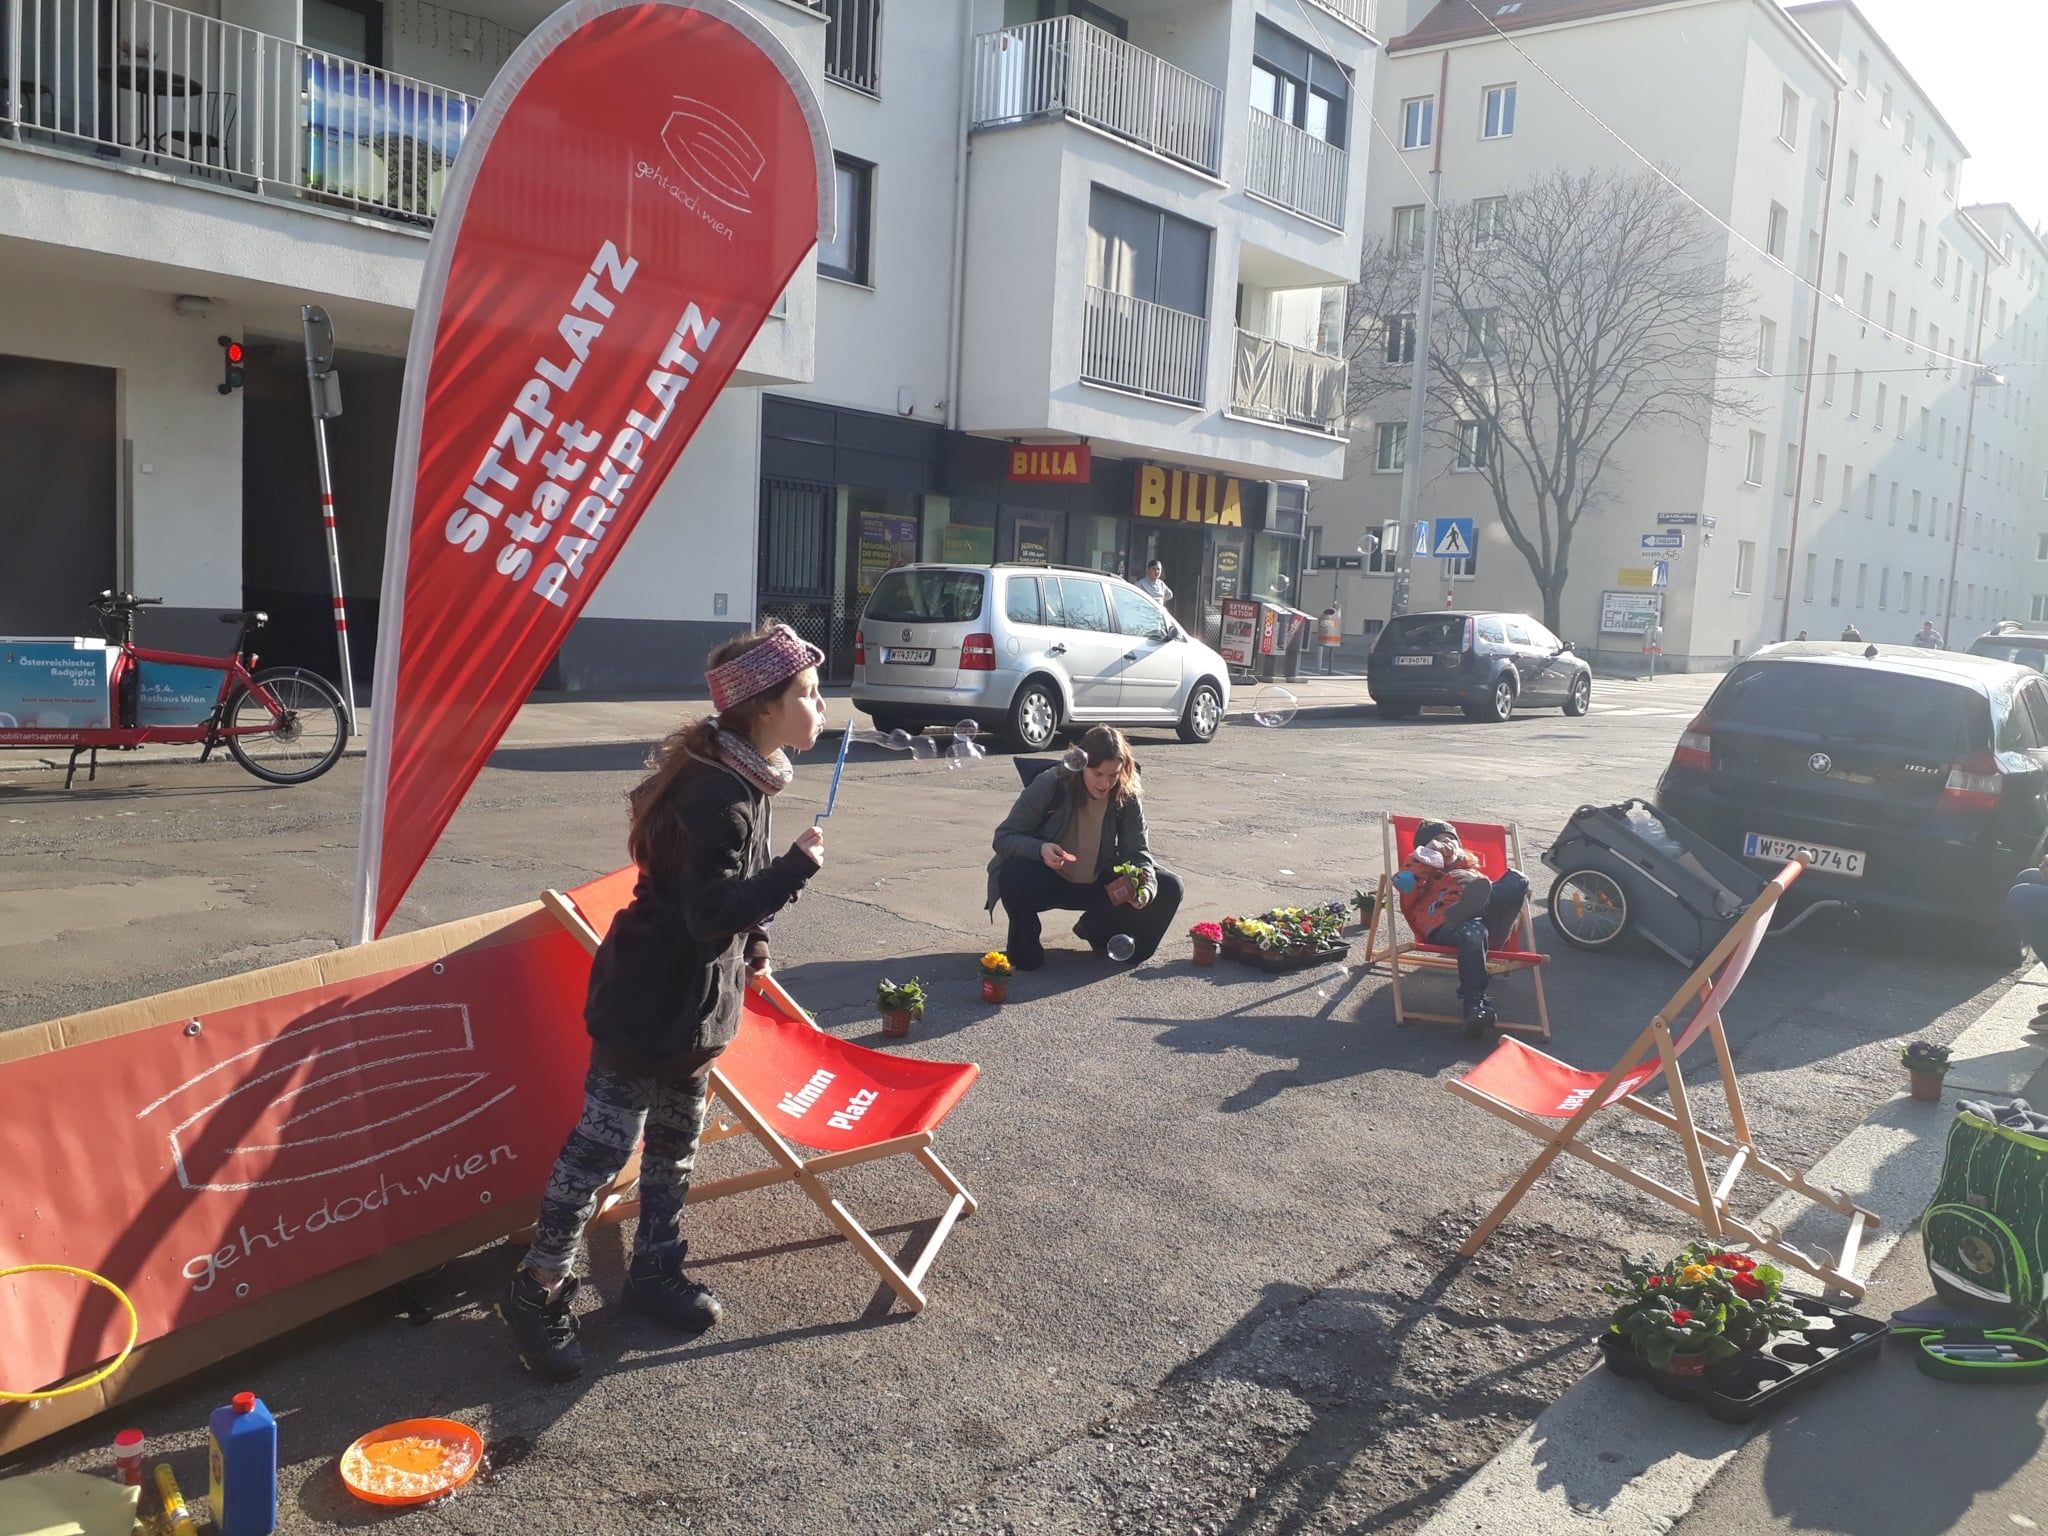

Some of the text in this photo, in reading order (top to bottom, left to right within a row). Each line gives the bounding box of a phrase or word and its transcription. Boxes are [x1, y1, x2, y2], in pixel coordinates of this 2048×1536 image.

[445, 239, 639, 553] SITZPLATZ
[532, 301, 721, 608] PARKPLATZ
[1012, 451, 1078, 475] BILLA
[496, 419, 602, 582] statt
[1140, 464, 1242, 527] BILLA
[1229, 603, 1254, 611] EXTREM
[1229, 610, 1253, 618] AKTION
[19, 656, 96, 667] Österreichischer
[51, 668, 96, 678] Radgipfel
[72, 678, 96, 687] 2022
[140, 694, 206, 704] Rathaus Wien
[1760, 838, 1772, 857] W
[1846, 854, 1858, 872] C
[776, 1068, 837, 1119] Nimm
[827, 1088, 879, 1131] Platz
[182, 1144, 518, 1292] geht-doch.wien
